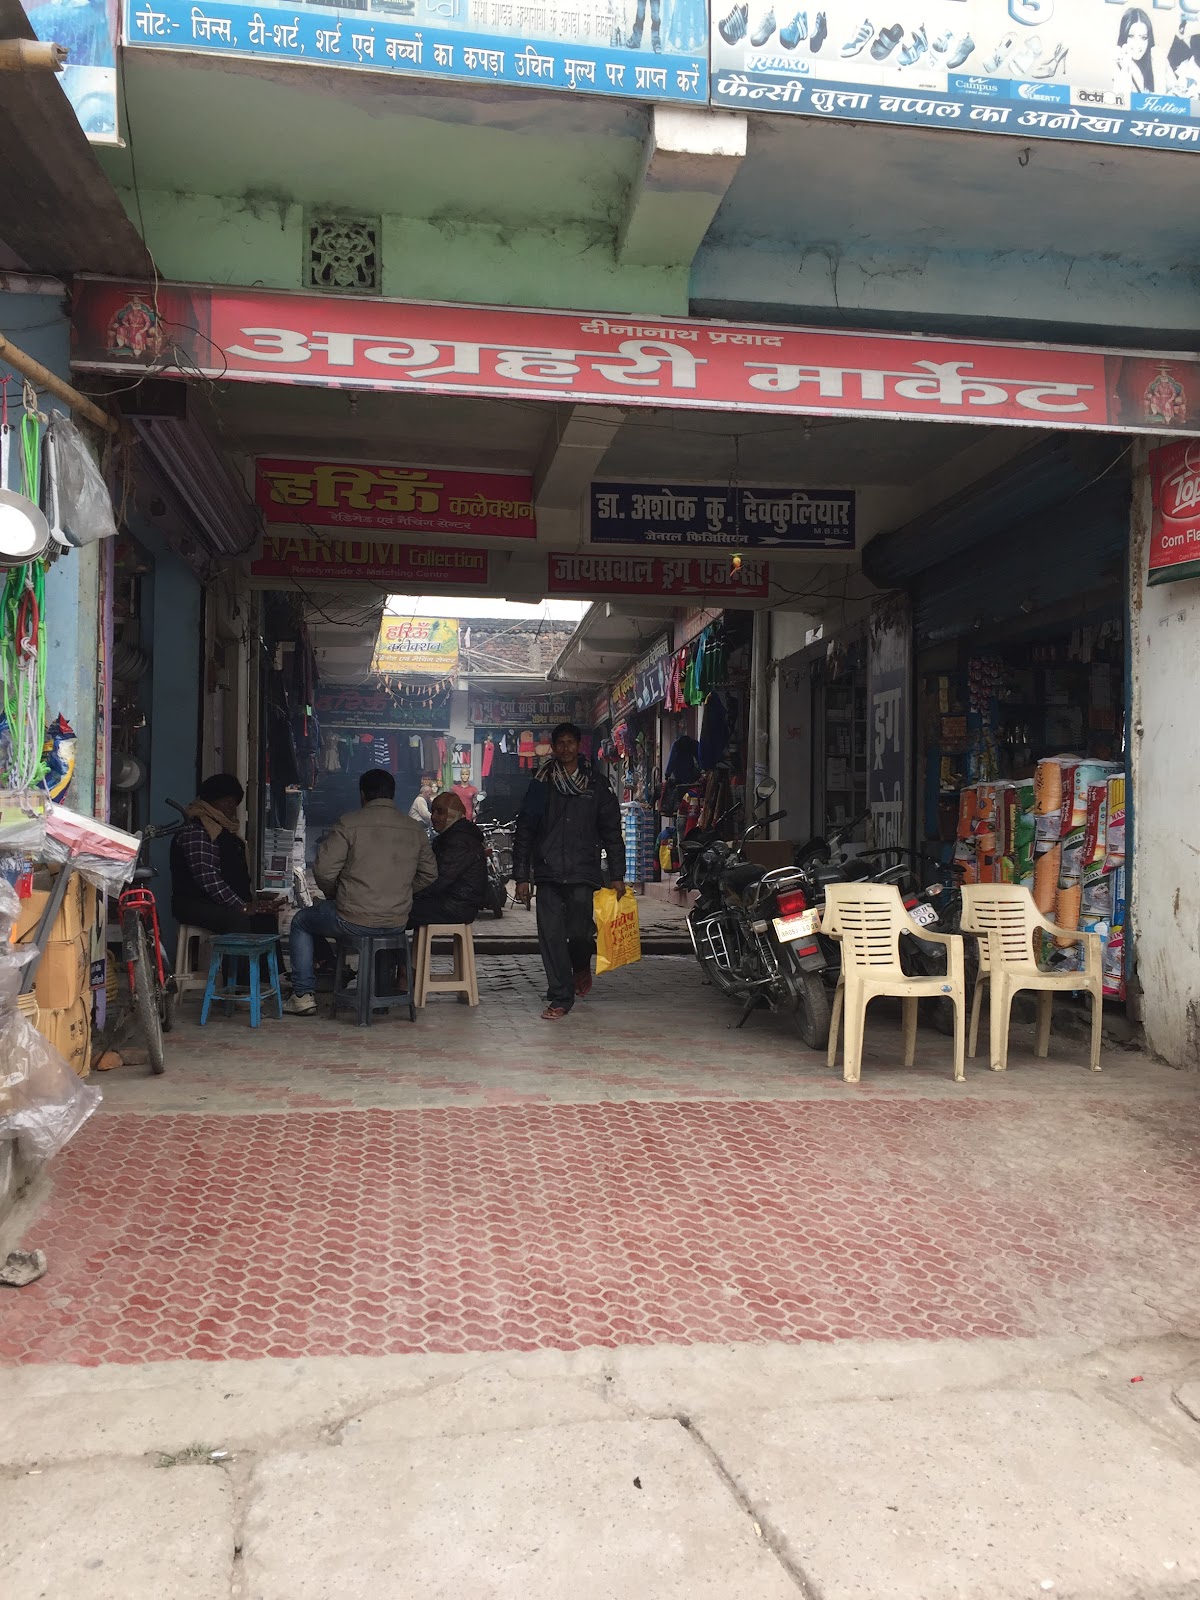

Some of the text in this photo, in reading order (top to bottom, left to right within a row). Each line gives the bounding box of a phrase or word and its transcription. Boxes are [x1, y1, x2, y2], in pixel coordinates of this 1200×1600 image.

[191, 7, 237, 46] जिन्स,
[248, 12, 304, 54] टी-शर्ट,
[316, 22, 342, 53] शर्ट
[352, 27, 375, 62] एवं
[385, 33, 423, 65] बच्चों
[434, 43, 453, 67] का
[464, 47, 504, 77] कपड़ा
[515, 45, 554, 78] उचित
[564, 59, 595, 90] मुल्य
[606, 63, 625, 87] पर
[635, 66, 667, 90] प्राप्त
[677, 63, 700, 94] करें
[956, 80, 998, 92] Campus
[1029, 94, 1061, 103] LIBERTY
[879, 96, 963, 118] चप्पल
[970, 104, 1012, 124] का
[1017, 109, 1124, 134] अनोखा
[1130, 118, 1200, 141] संगम
[581, 320, 785, 348] दीनानाथ प्रसाद
[223, 327, 1094, 413] अग्रहरी मार्केट
[448, 491, 534, 520] कलेक्शन
[596, 493, 625, 519] डा.
[631, 488, 698, 521] अशोक
[644, 530, 682, 542] जेनरल
[1162, 535, 1184, 548] Corn
[409, 548, 484, 569] Collection
[292, 565, 449, 579] Readymade & Matching Centre
